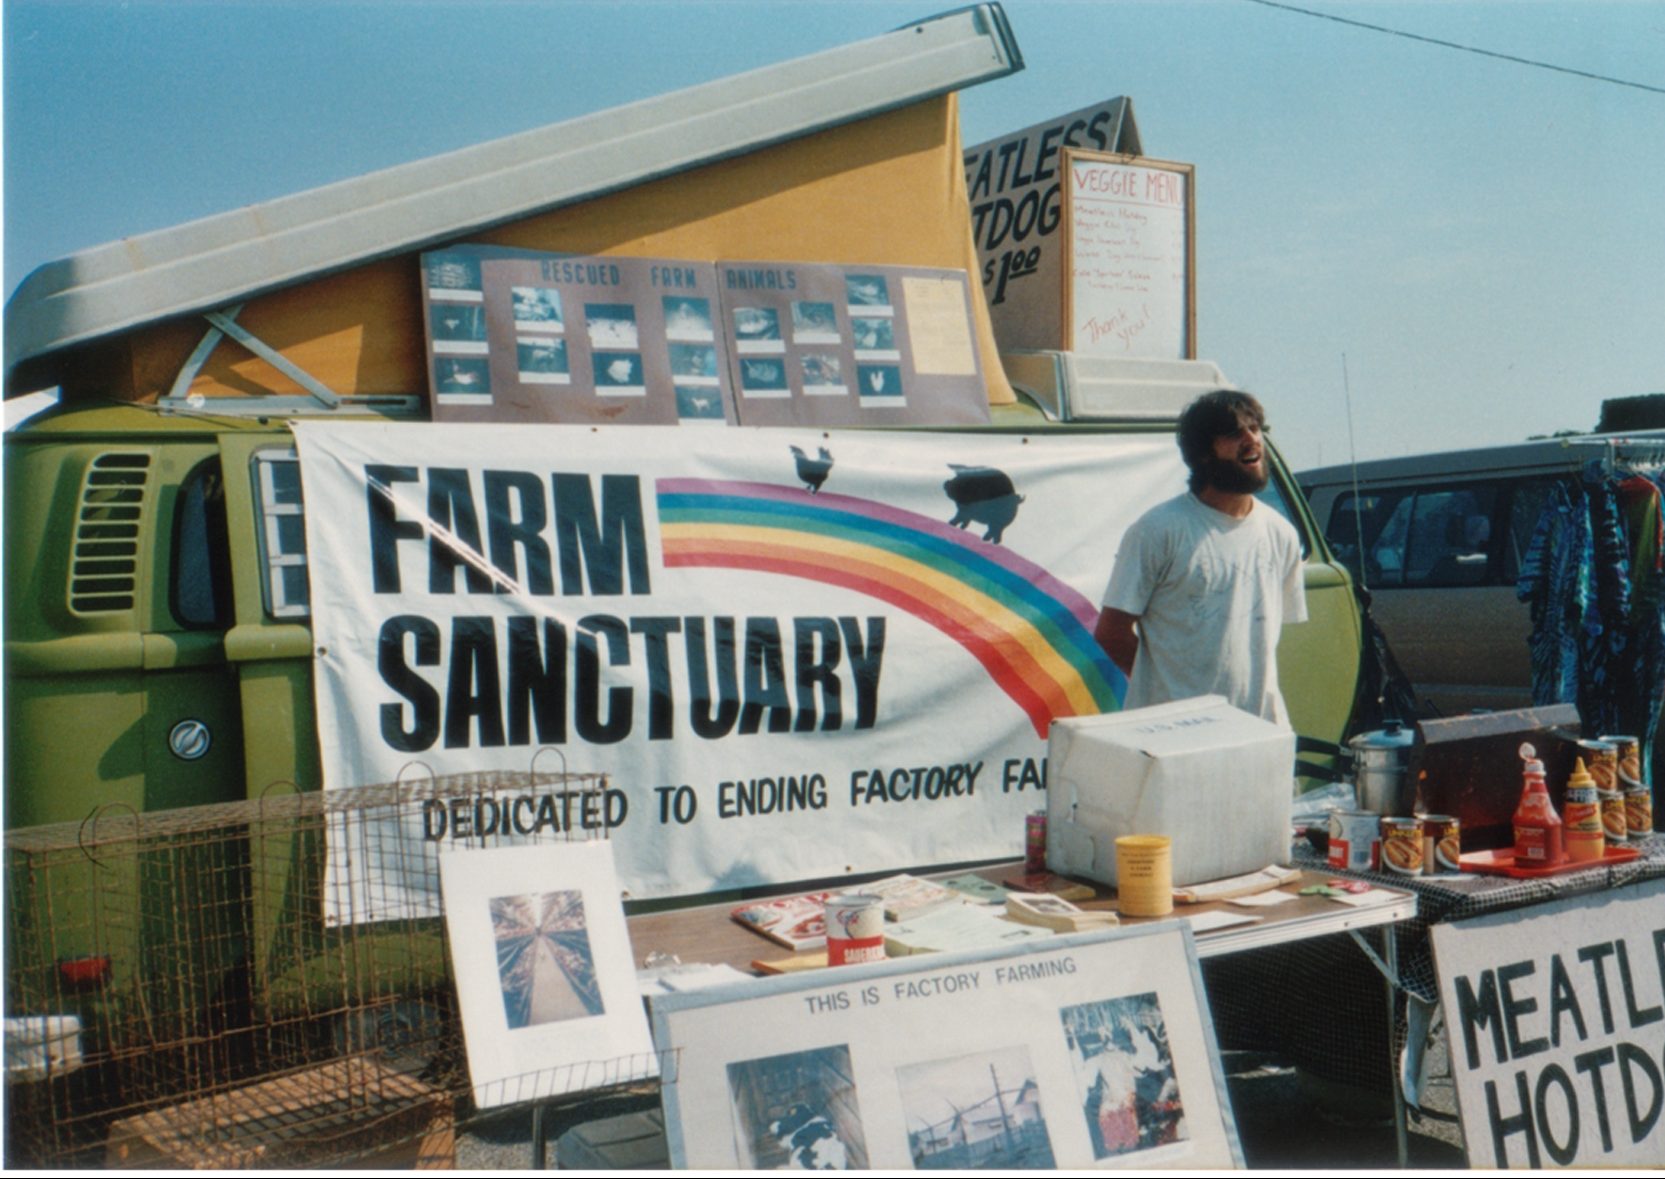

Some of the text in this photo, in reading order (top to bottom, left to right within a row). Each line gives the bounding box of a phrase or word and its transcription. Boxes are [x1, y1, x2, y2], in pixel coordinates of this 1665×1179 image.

[1074, 168, 1136, 197] VEGGIE
[541, 259, 797, 290] RESCUED FARM ANIMALS
[1082, 307, 1126, 344] Thank
[364, 464, 651, 595] FARM
[377, 614, 886, 753] SANCTUARY
[423, 758, 1047, 842] DEDICATED TO ENDING FACTORY FA
[805, 956, 1076, 1014] THIS IS FACTORY FARMING
[1484, 1042, 1665, 1169] HOTD
